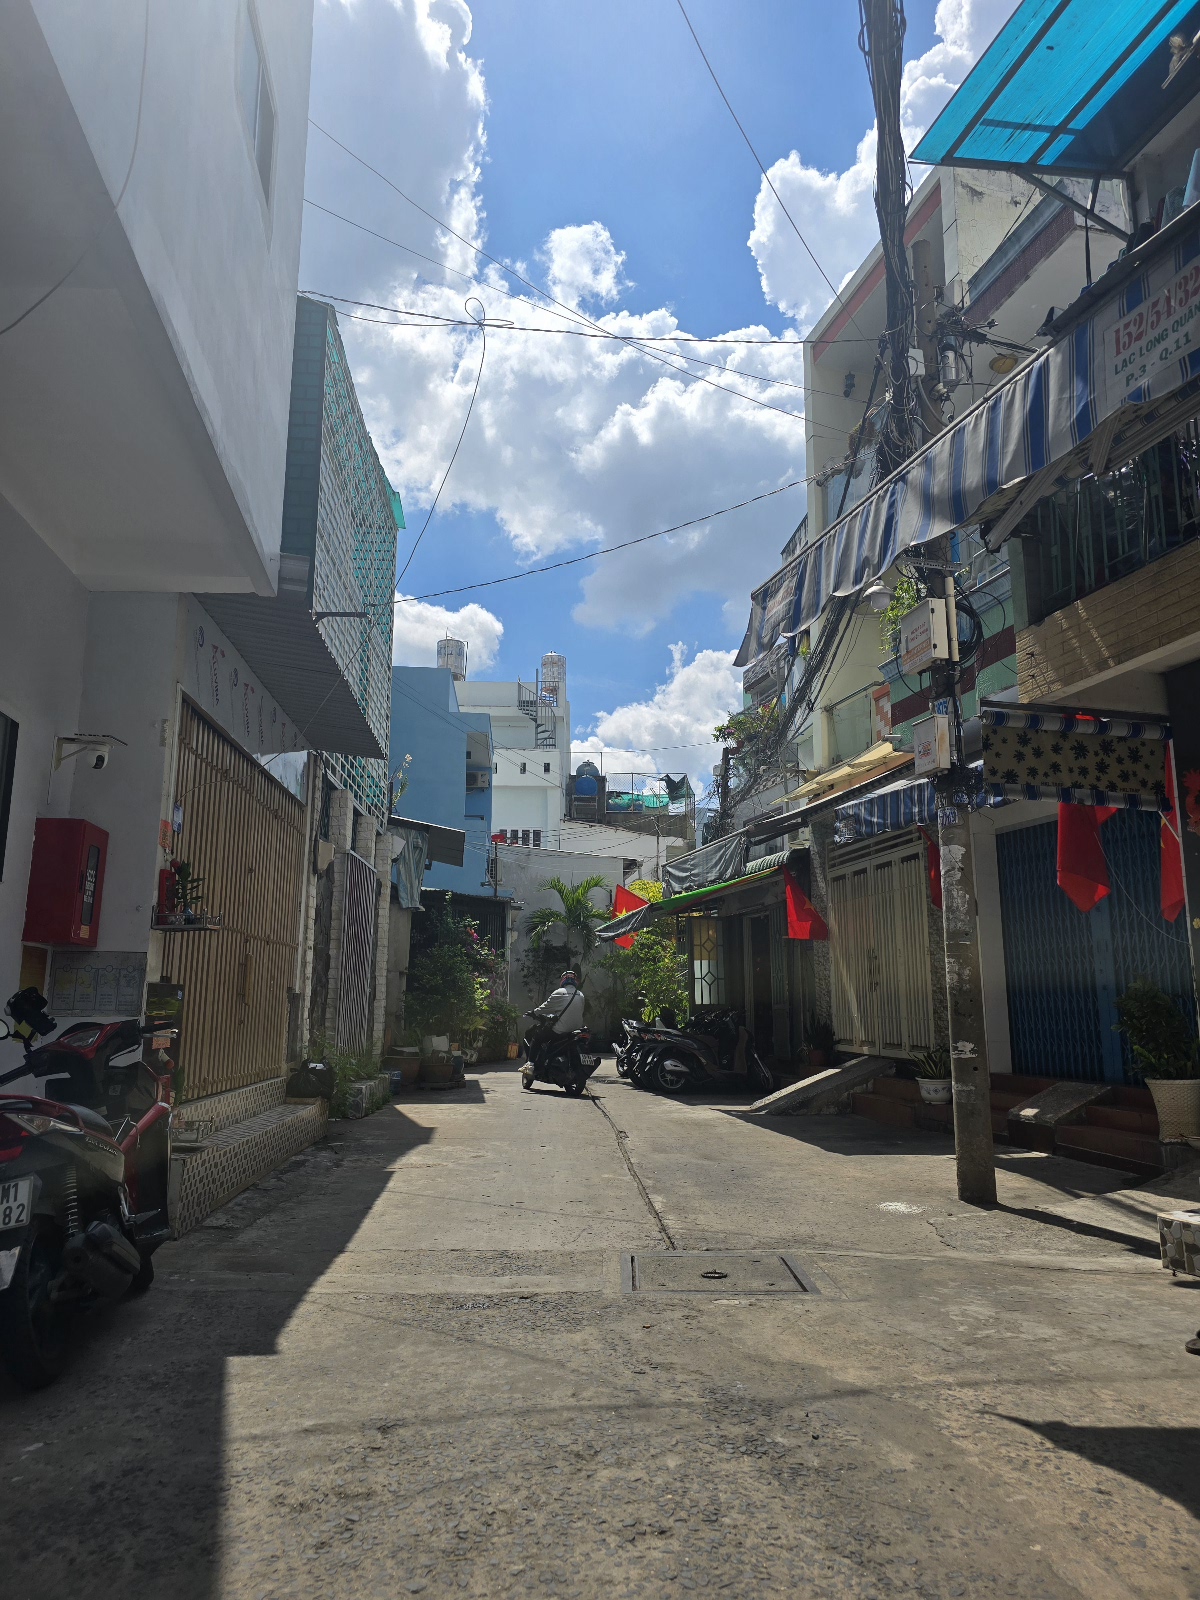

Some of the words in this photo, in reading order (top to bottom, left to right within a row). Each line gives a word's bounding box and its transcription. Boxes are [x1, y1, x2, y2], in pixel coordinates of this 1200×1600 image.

[1114, 355, 1136, 377] LẠC
[1138, 328, 1169, 358] LONG
[1125, 363, 1147, 388] P.3
[1159, 331, 1192, 362] Q.11
[2, 1202, 25, 1226] 82
